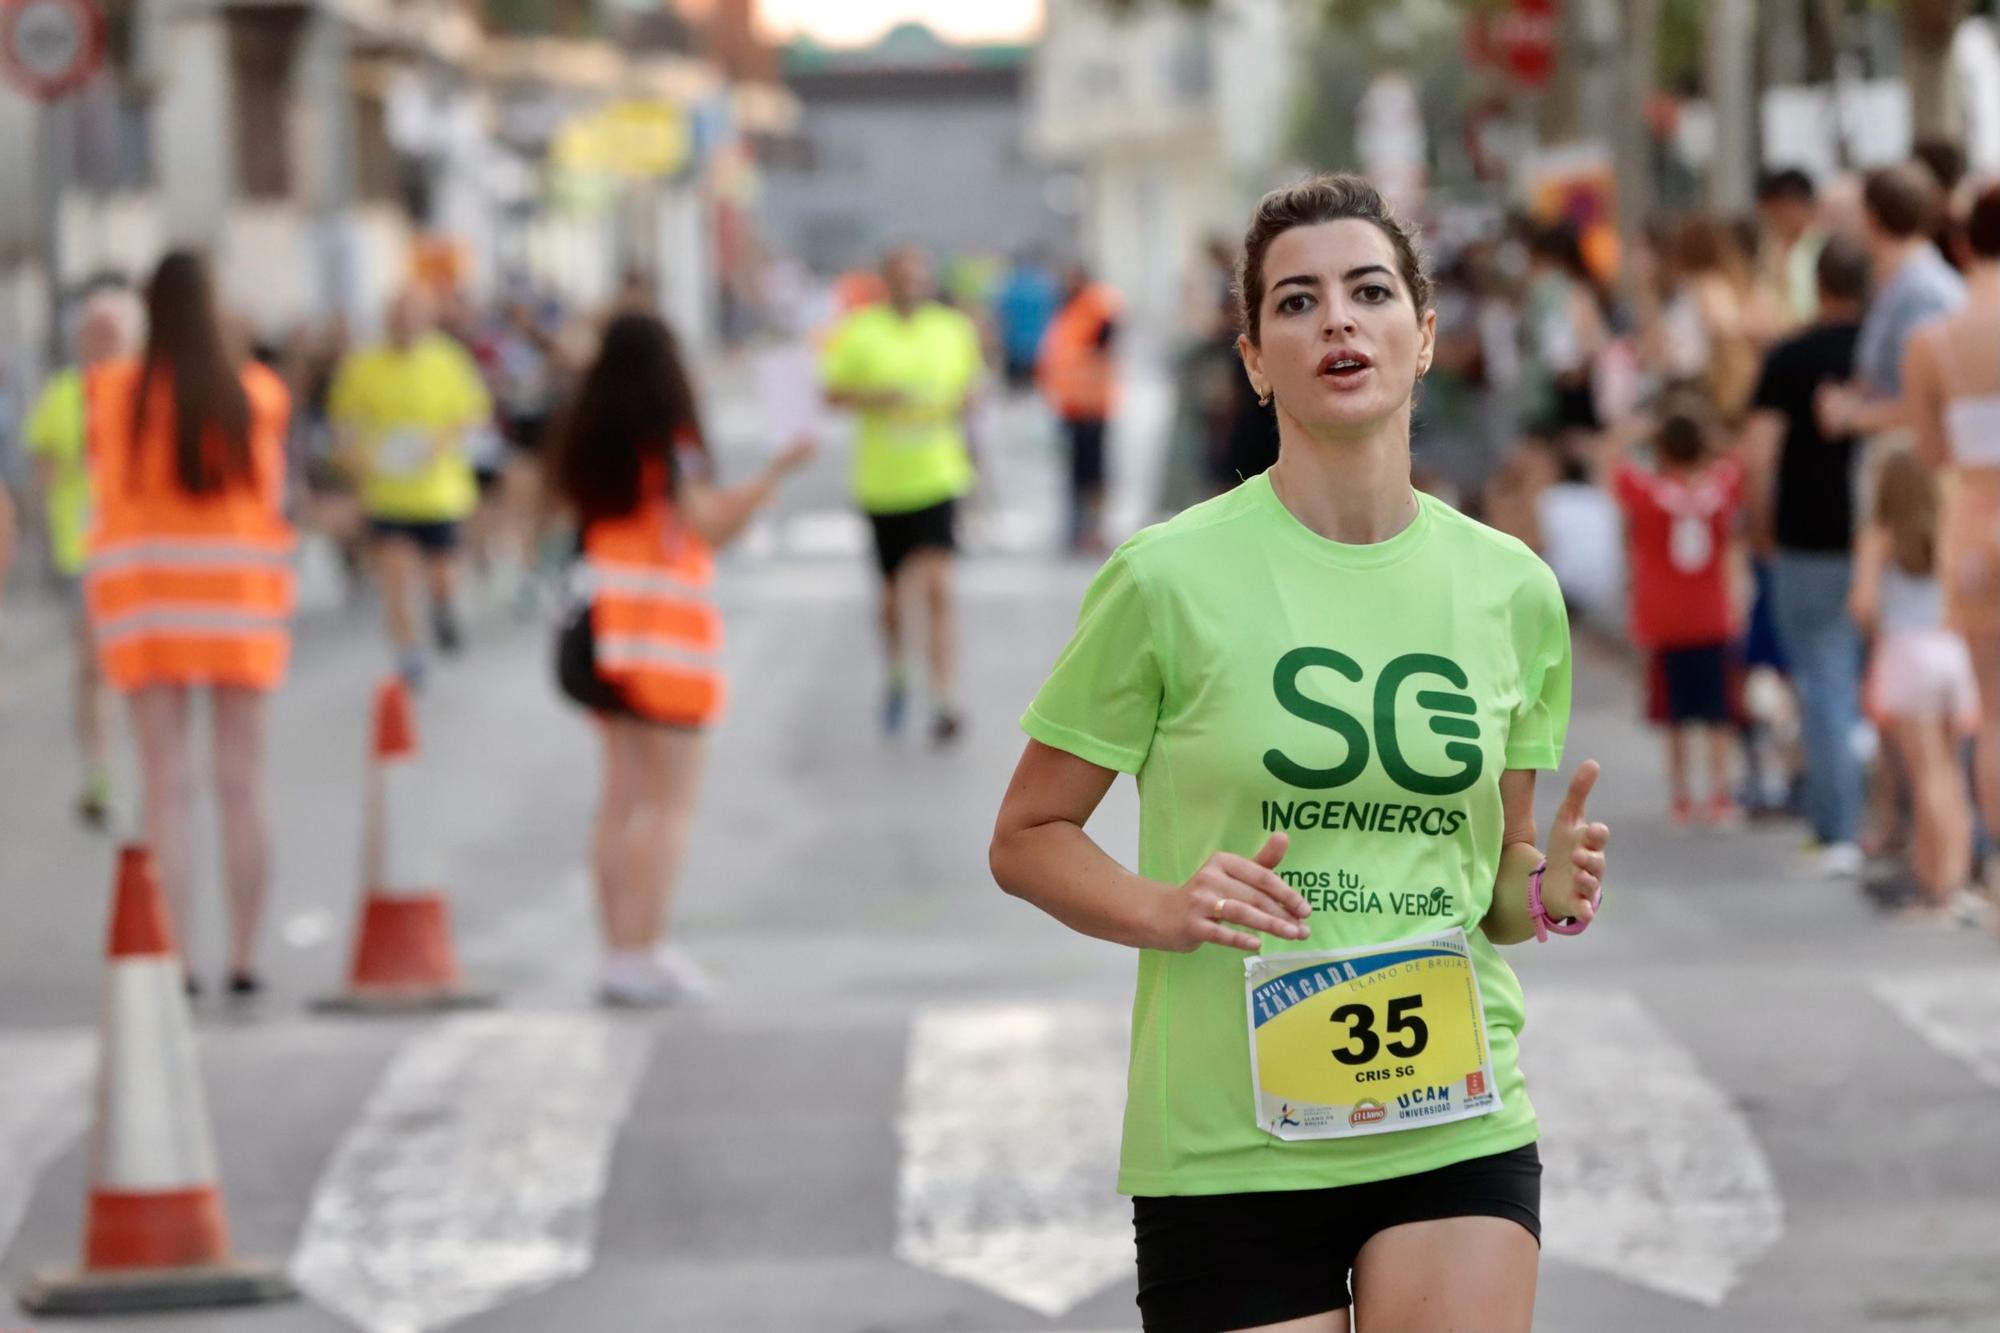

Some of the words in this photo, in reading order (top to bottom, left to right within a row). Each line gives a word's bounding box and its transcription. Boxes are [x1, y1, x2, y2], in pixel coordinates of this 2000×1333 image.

[1263, 647, 1483, 795] SG
[1262, 801, 1467, 836] INGENIEROS
[1279, 869, 1330, 888] mos
[1338, 869, 1359, 889] tu
[1389, 887, 1454, 917] VERDE
[1349, 968, 1398, 991] LLANO
[1406, 962, 1421, 973] DE
[1428, 958, 1470, 969] BRUJAS
[1256, 979, 1286, 1001] XVIII
[1259, 961, 1358, 1019] ZANCADA
[1329, 993, 1429, 1066] 35
[1355, 1068, 1391, 1083] CRIS
[1395, 1065, 1415, 1078] SG
[1397, 1086, 1449, 1109] UCAM
[1399, 1102, 1451, 1119] UNIVERSIDAD
